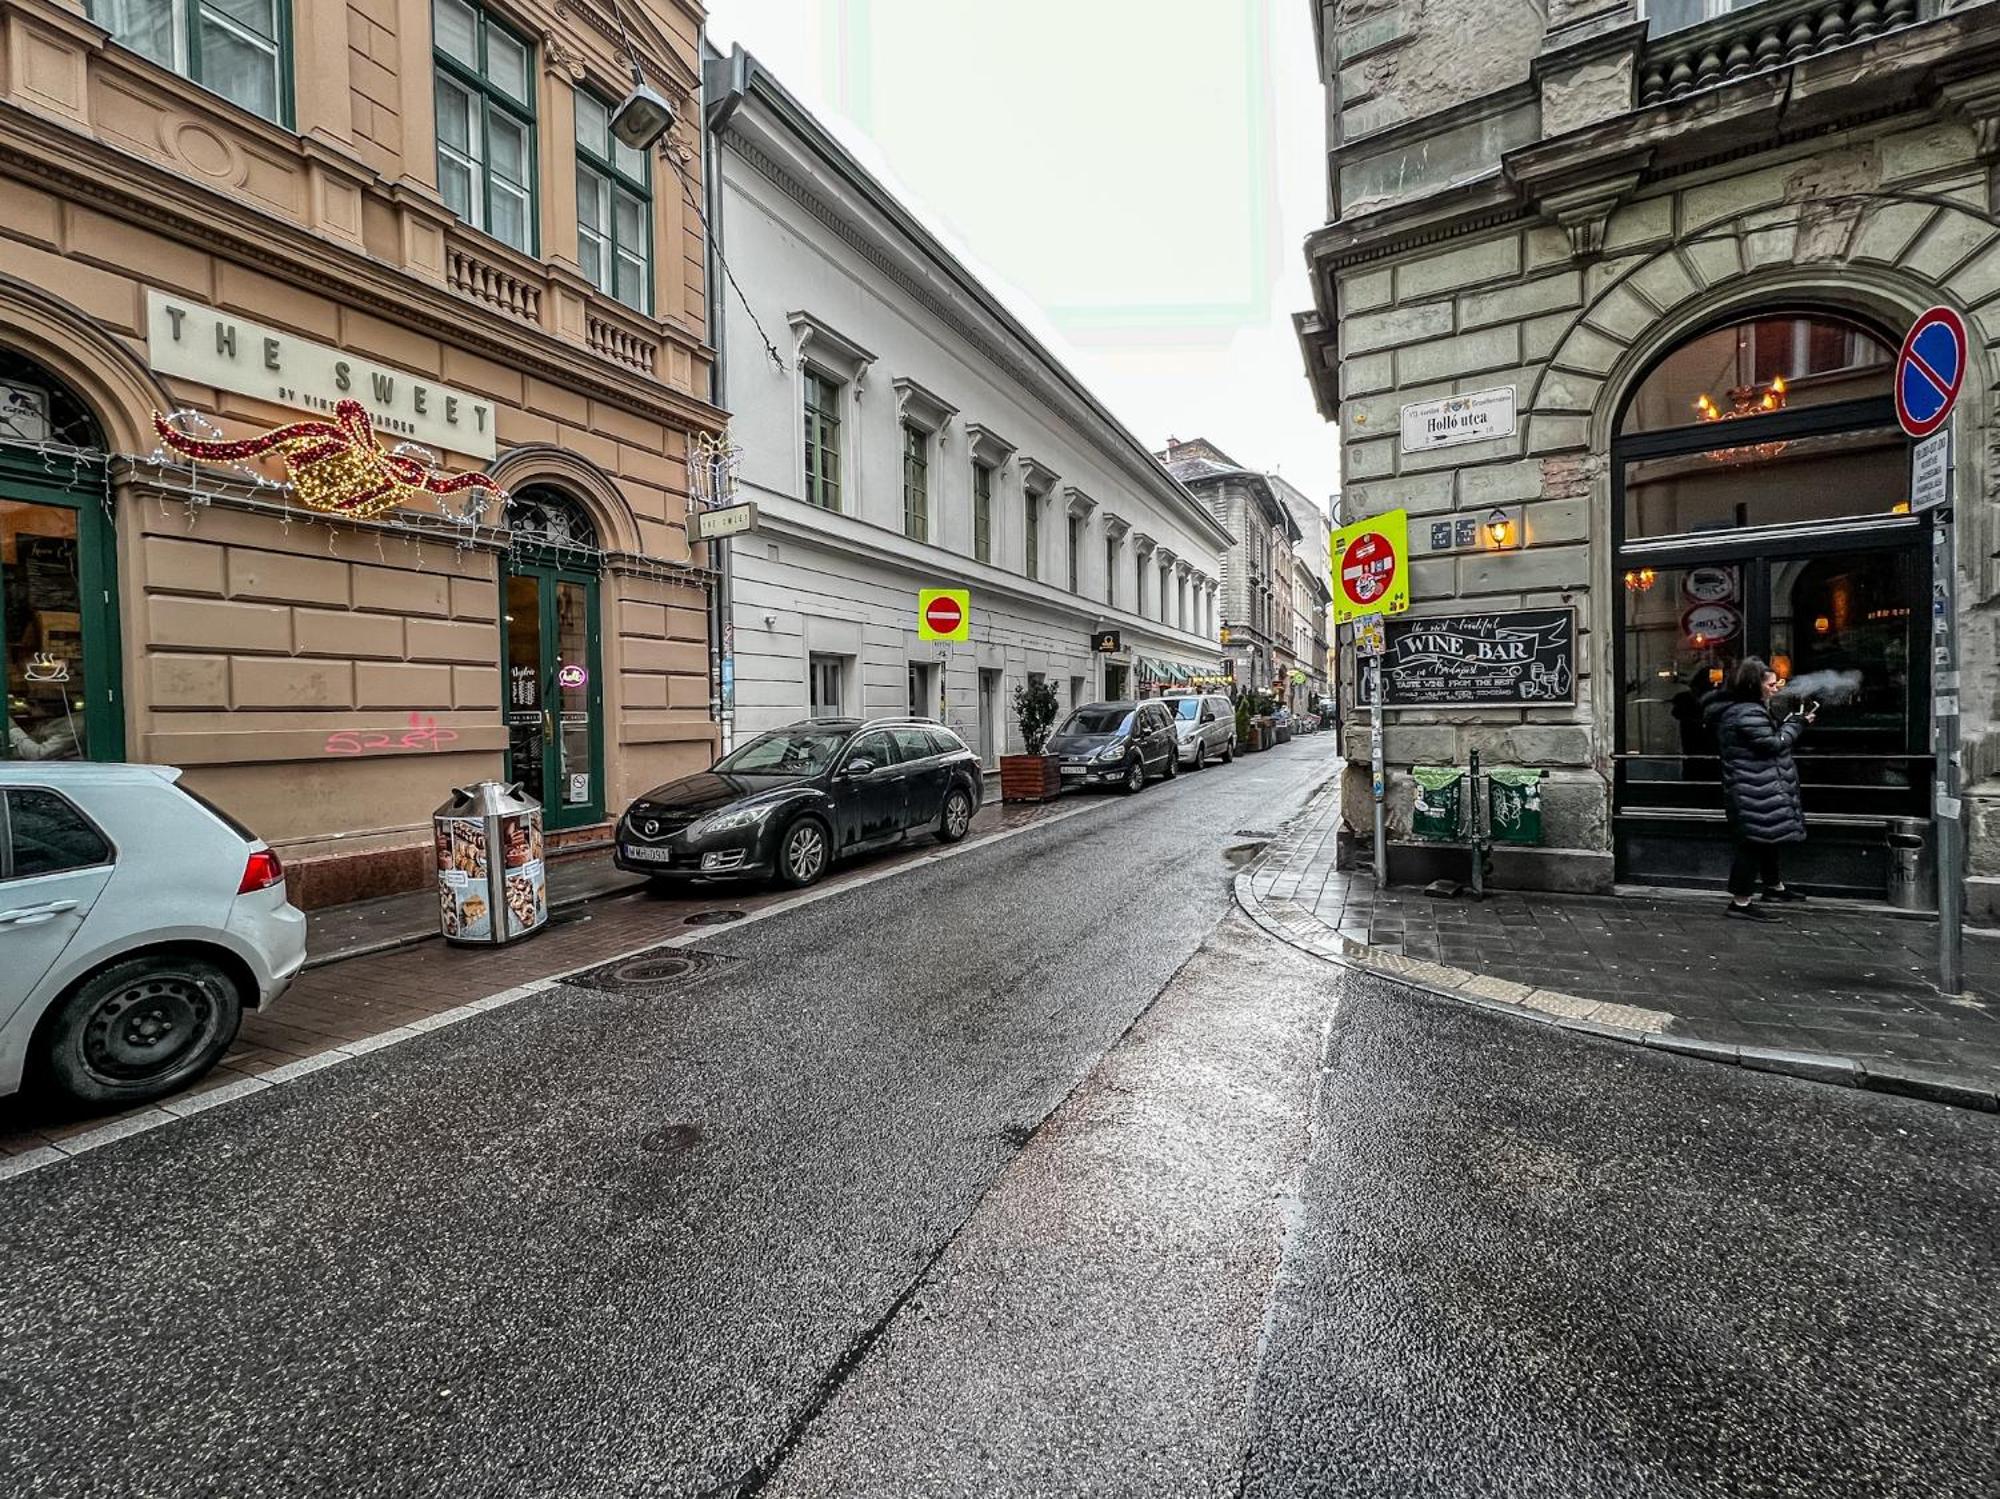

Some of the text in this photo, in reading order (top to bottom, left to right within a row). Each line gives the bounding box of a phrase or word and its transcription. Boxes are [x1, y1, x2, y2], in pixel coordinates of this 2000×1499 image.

[165, 304, 488, 433] THE SWEET
[278, 387, 295, 401] BY
[1427, 411, 1488, 433] Holló utca
[1404, 635, 1464, 656] WINE
[1477, 641, 1529, 660] BAR
[1448, 679, 1471, 687] FROM
[1475, 679, 1492, 687] THE
